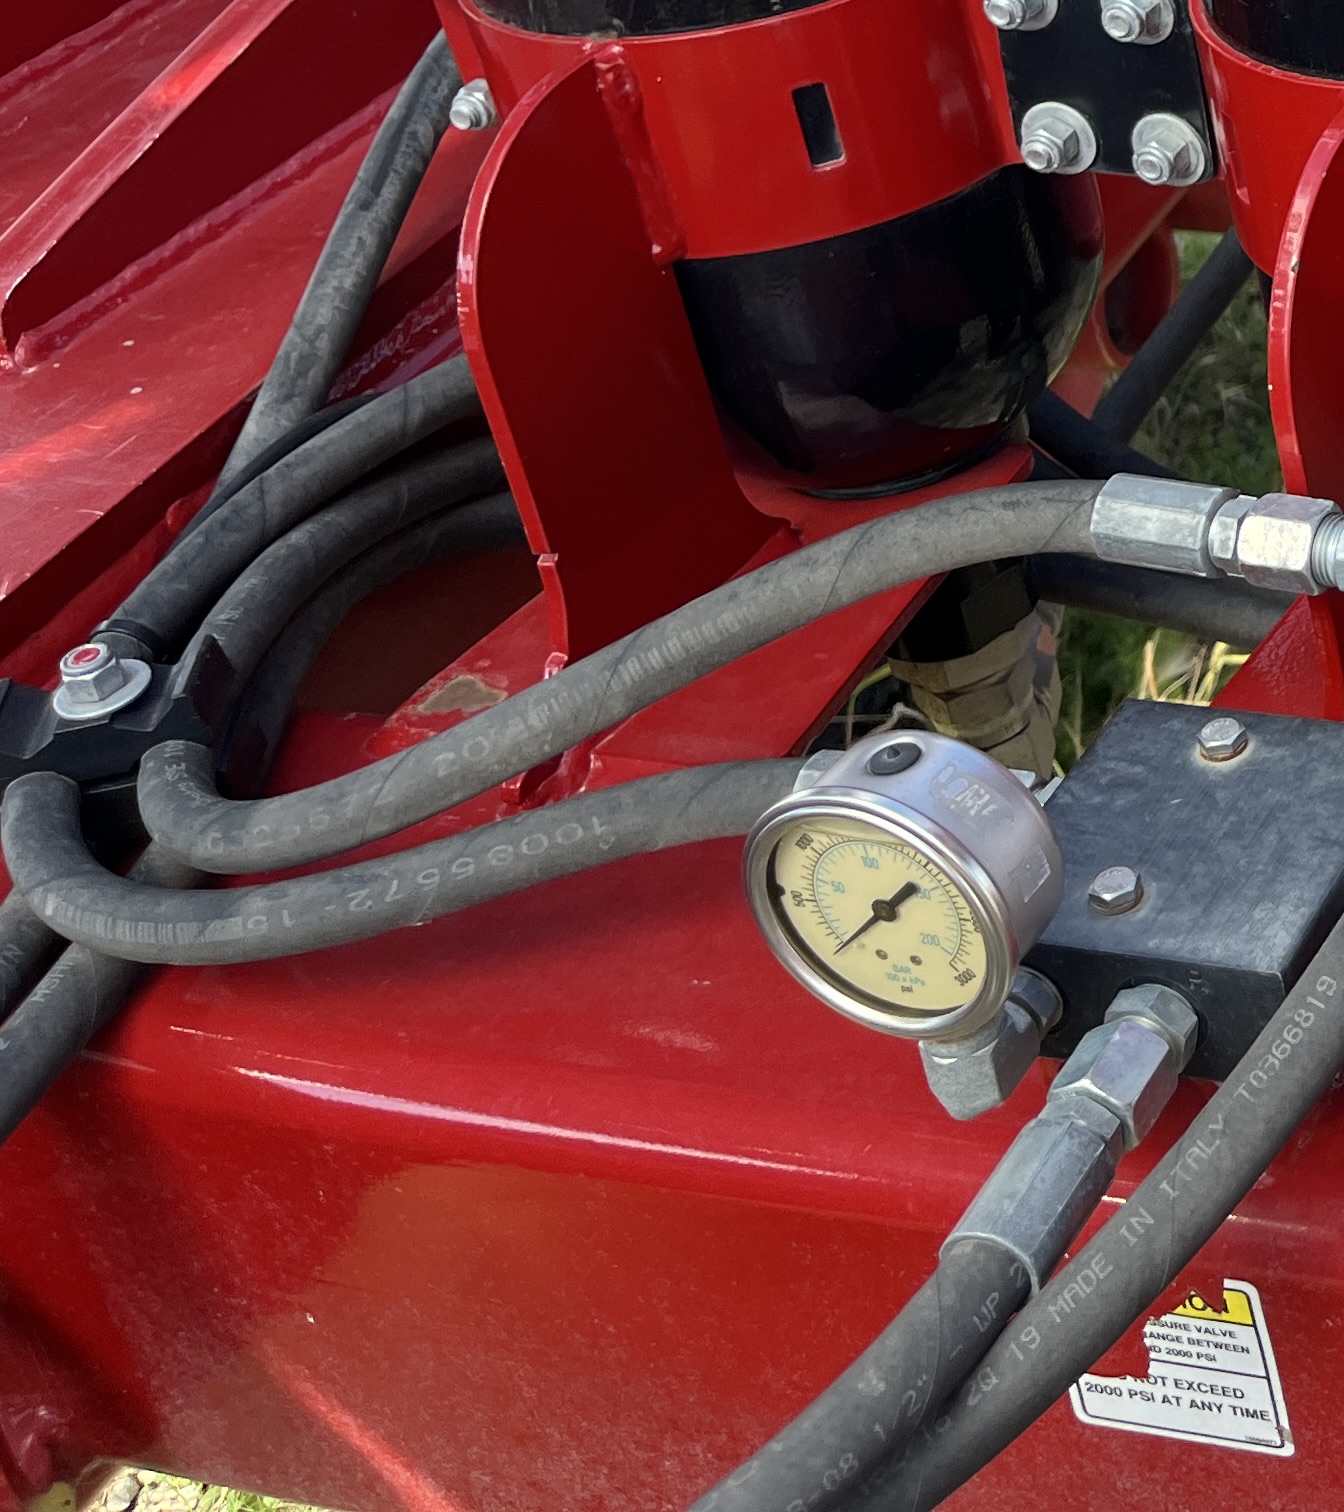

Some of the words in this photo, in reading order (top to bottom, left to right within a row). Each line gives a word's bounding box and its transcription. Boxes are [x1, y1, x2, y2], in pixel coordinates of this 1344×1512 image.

[859, 854, 880, 870] 100
[830, 879, 846, 895] 50
[919, 932, 940, 948] 200
[954, 967, 977, 987] 3000
[900, 984, 914, 994] psi
[1008, 1324, 1041, 1363] 19
[1047, 1246, 1114, 1324] MADE
[1119, 1205, 1155, 1248] IN
[1158, 1112, 1226, 1201] ITALY
[1232, 973, 1338, 1104] T0366819
[1194, 1326, 1238, 1339] VALVE
[1187, 1337, 1250, 1355] BETWEEN
[1165, 1347, 1193, 1359] 2000
[1197, 1352, 1217, 1363] PSI
[1173, 1378, 1245, 1400] EXCEED
[1085, 1381, 1124, 1398] 2000
[1128, 1387, 1156, 1403] PSI
[1161, 1394, 1182, 1407] AT
[1189, 1399, 1224, 1414] ANY
[1228, 1404, 1273, 1422] TIME
